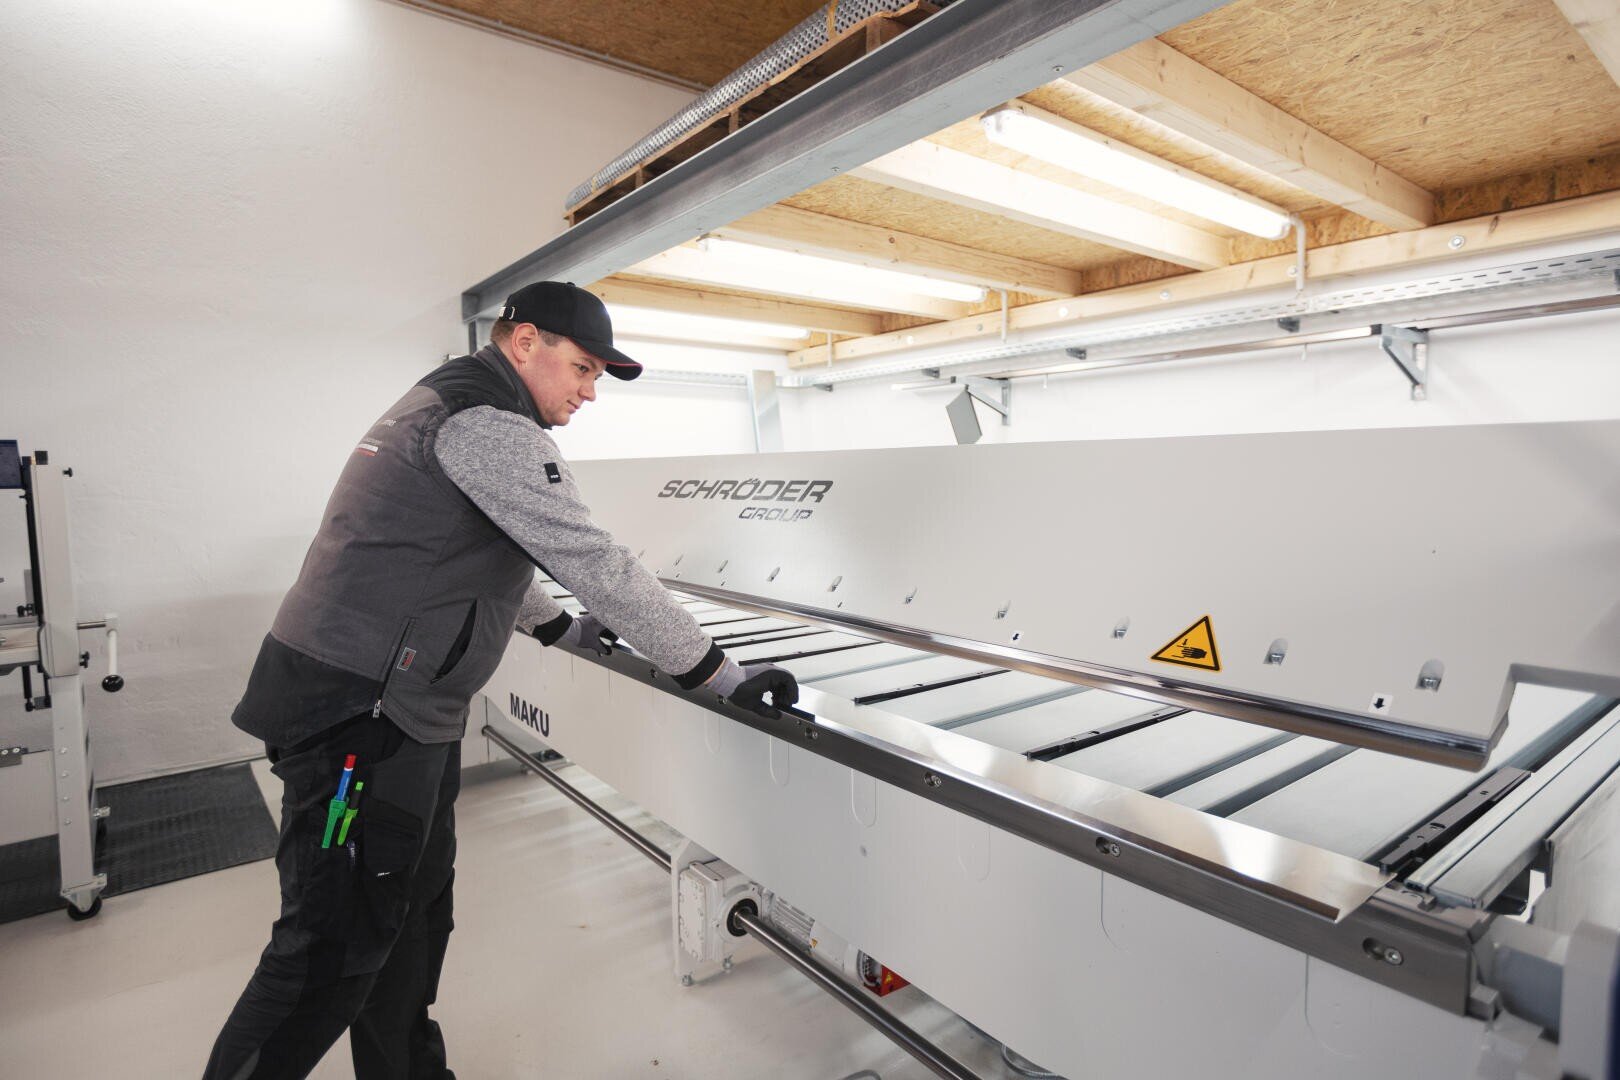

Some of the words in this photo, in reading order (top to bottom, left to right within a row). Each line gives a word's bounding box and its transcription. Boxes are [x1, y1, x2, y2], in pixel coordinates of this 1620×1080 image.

[657, 478, 834, 503] SCHRÖDER
[738, 506, 813, 522] GROUP
[510, 692, 549, 737] MAKU
